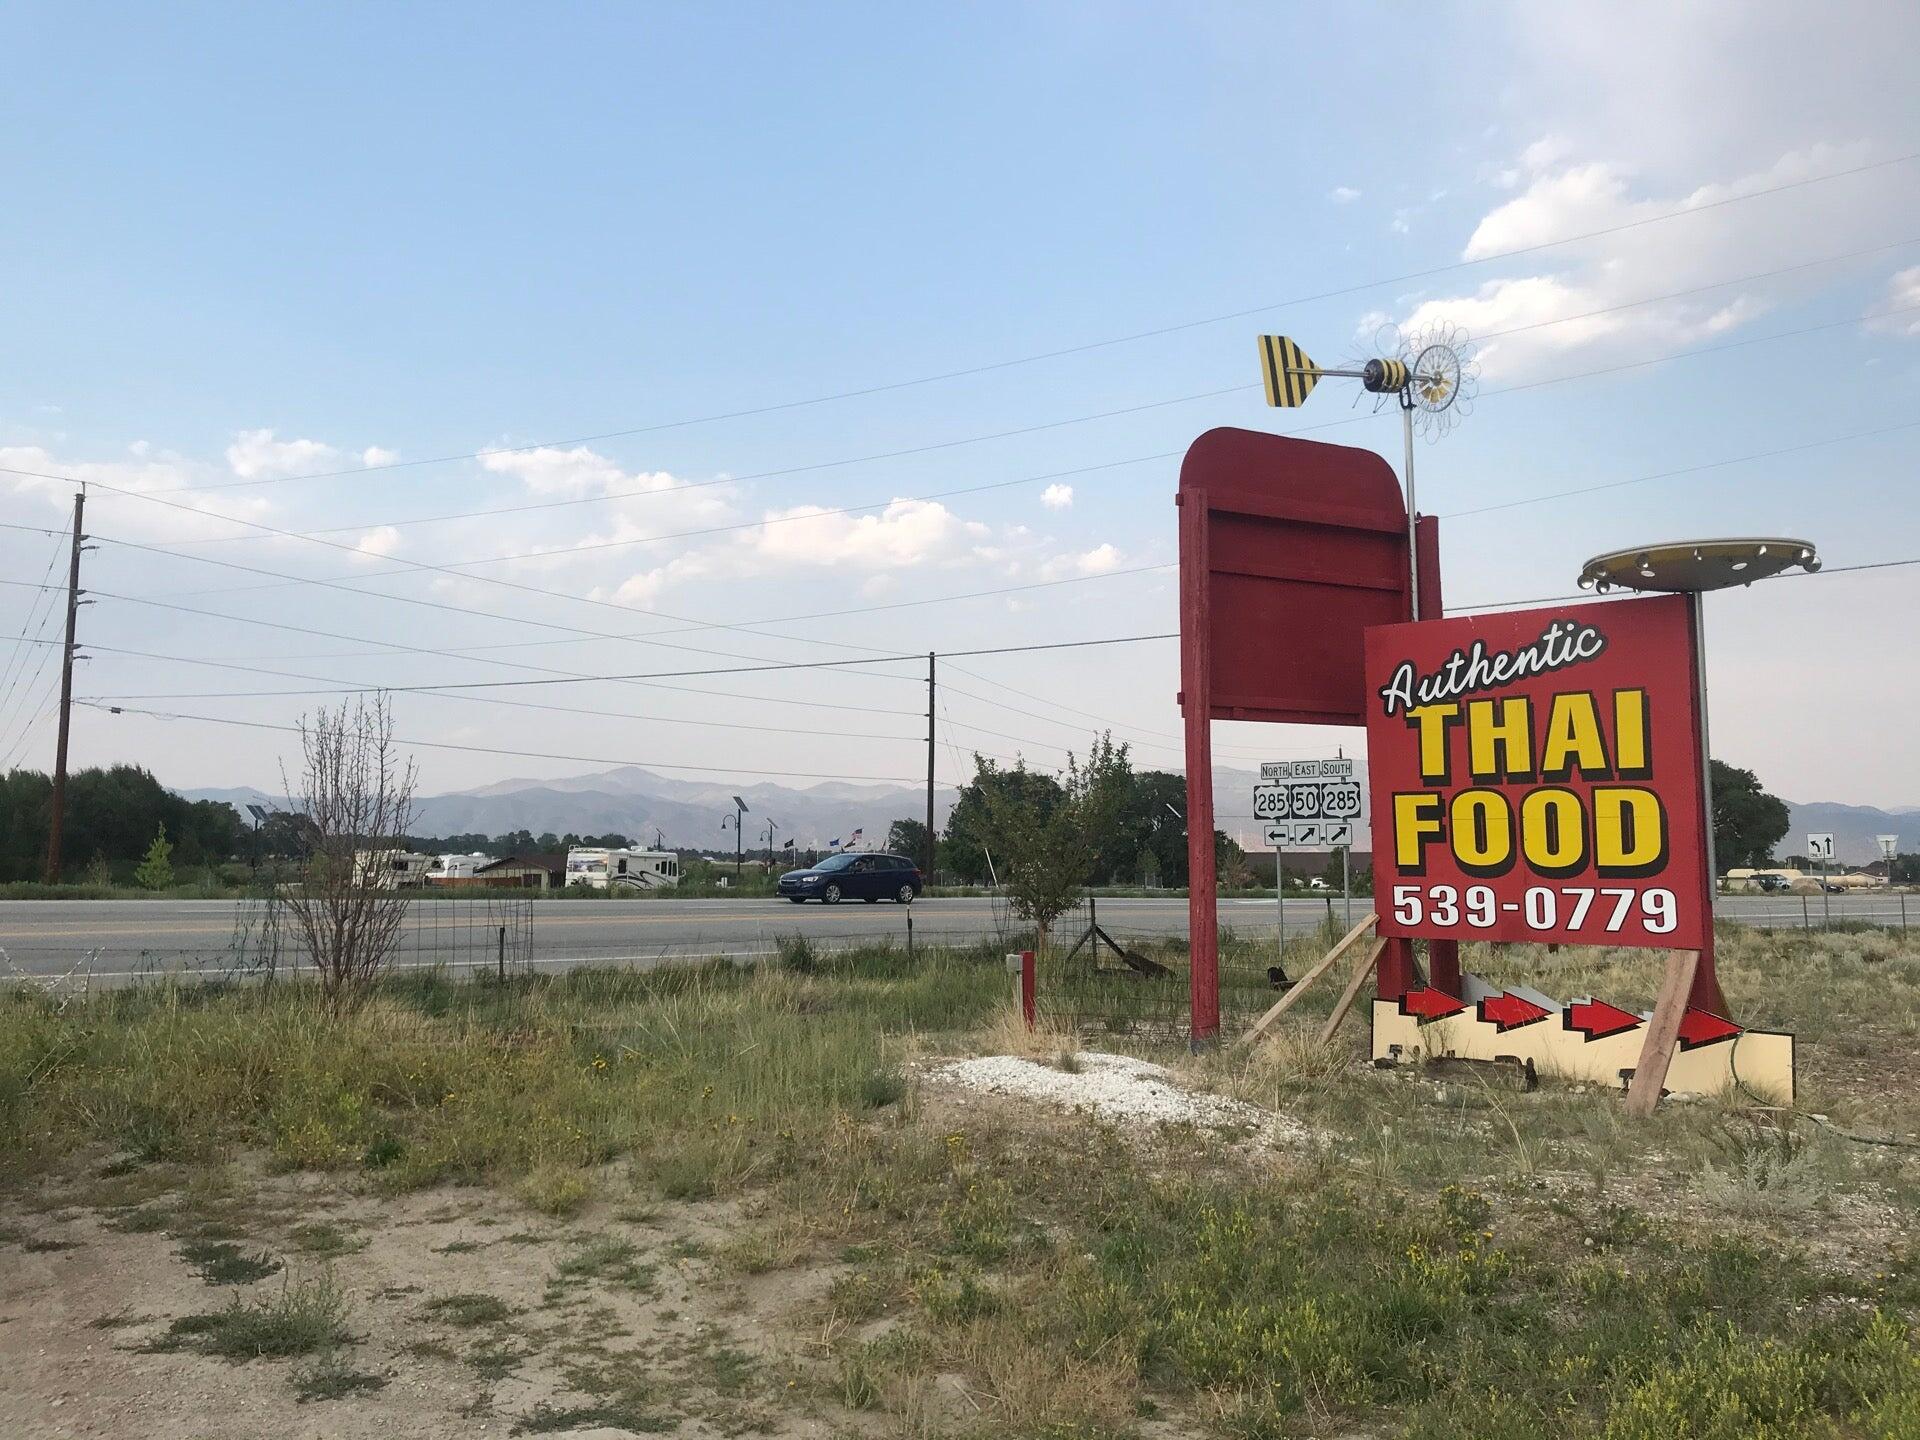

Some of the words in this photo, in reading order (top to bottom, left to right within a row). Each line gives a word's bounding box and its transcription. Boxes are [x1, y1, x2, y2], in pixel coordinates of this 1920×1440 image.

[1381, 622, 1603, 714] Authentic
[1406, 688, 1651, 782] THAI
[1262, 766, 1288, 777] NORTH
[1295, 764, 1316, 776] EAST
[1323, 763, 1351, 774] SOUTH
[1258, 793, 1285, 812] 285
[1295, 791, 1316, 811] 50
[1326, 791, 1357, 811] 285
[1392, 786, 1667, 876] FOOD
[1393, 885, 1678, 934] 539-0779
